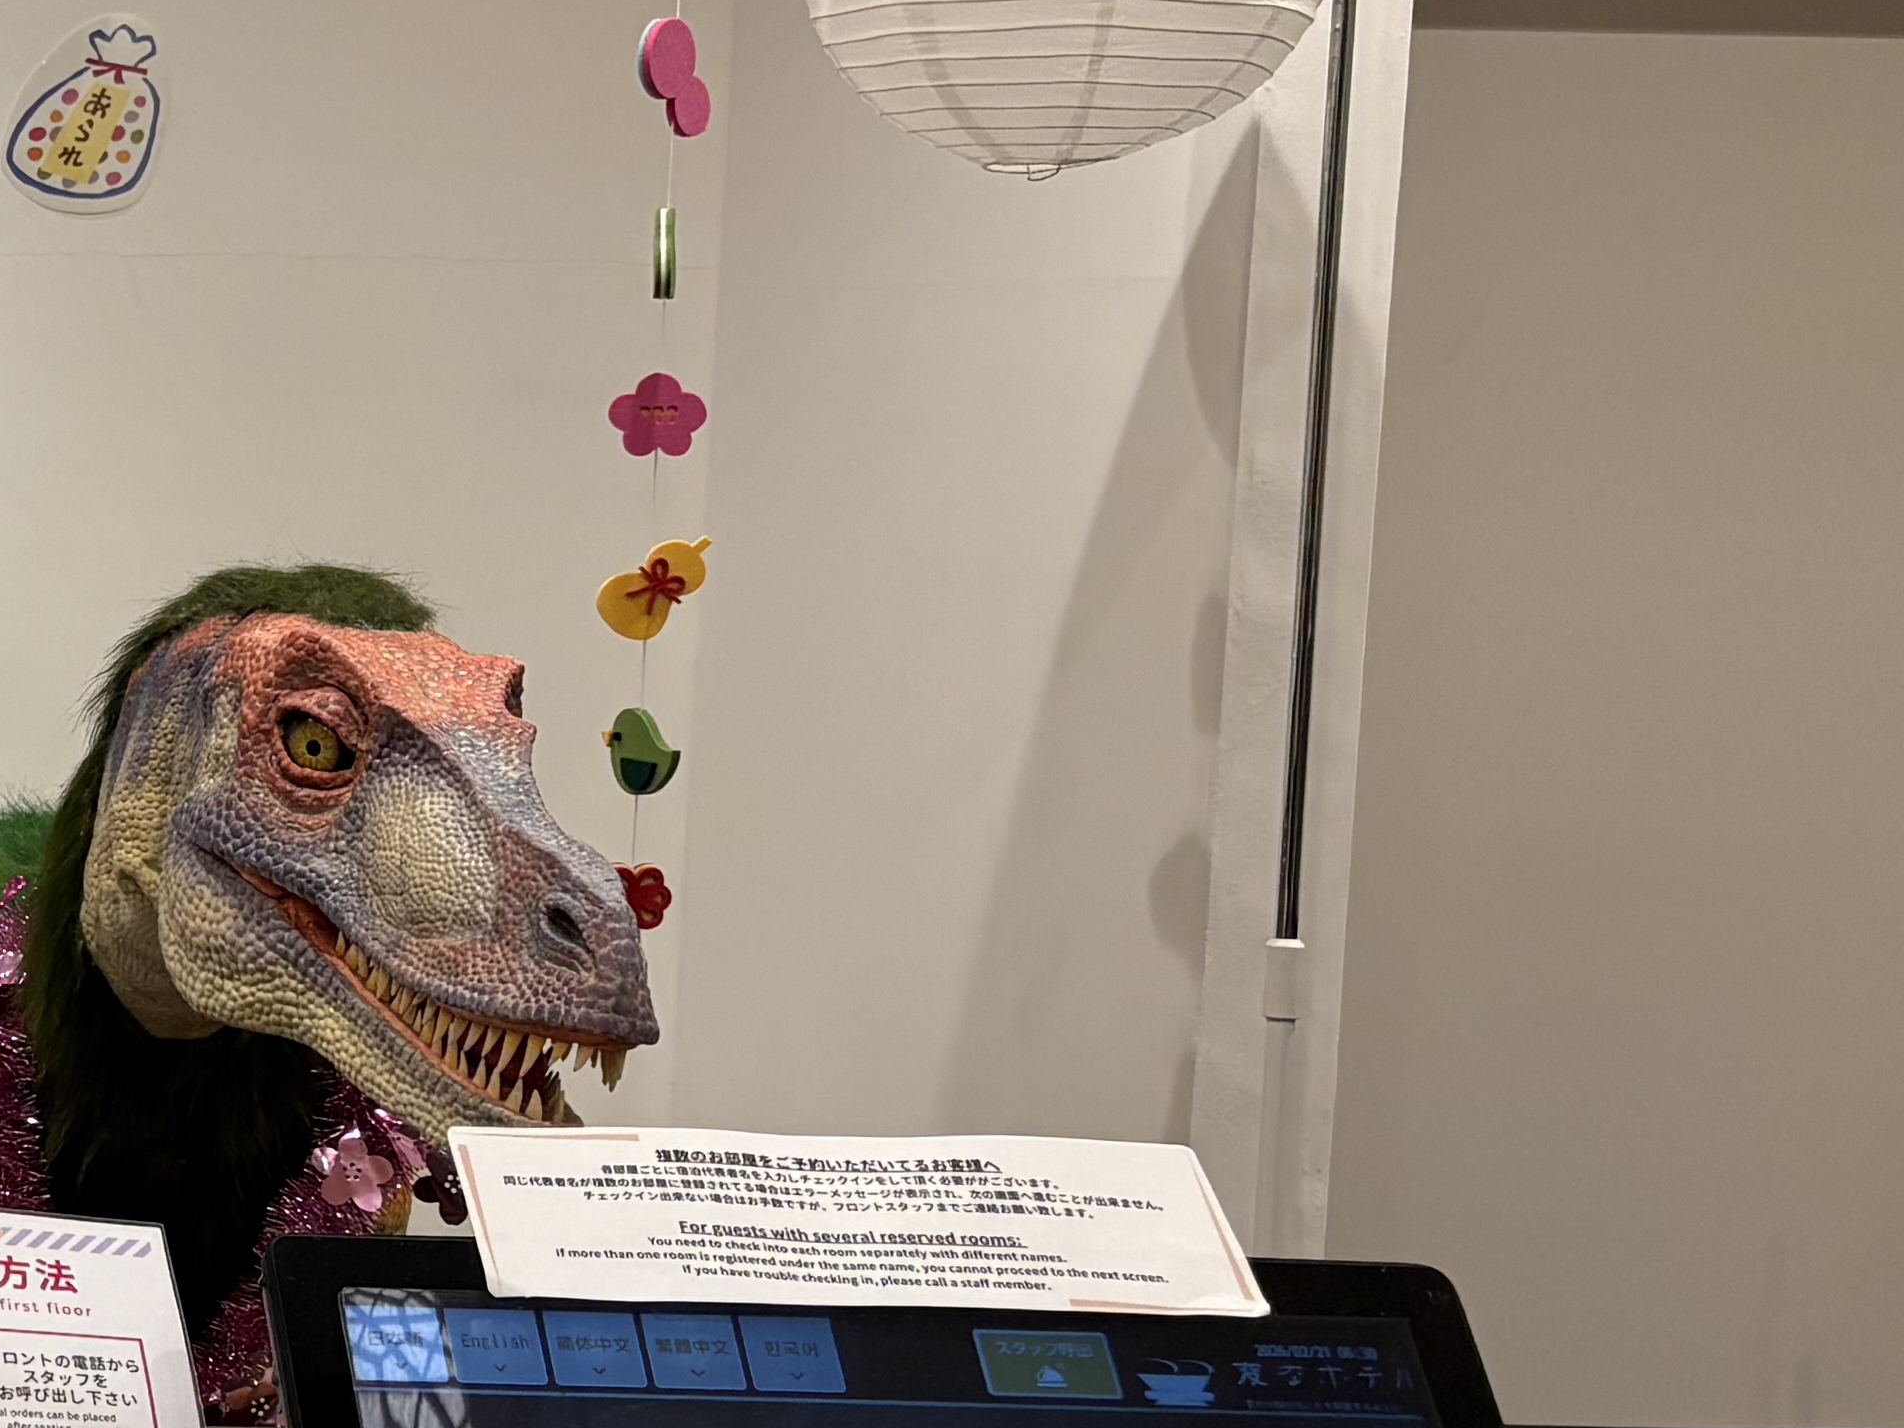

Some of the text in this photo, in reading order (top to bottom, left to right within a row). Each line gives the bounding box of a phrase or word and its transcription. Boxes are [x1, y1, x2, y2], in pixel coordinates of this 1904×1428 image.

[58, 88, 111, 167] あられ
[678, 1220, 1022, 1248] For guests with several reserved rooms:
[0, 1297, 38, 1312] first
[46, 1301, 90, 1316] floor
[460, 1331, 534, 1353] English
[762, 1339, 823, 1358] 한국어
[21, 1369, 107, 1390] スタッフを
